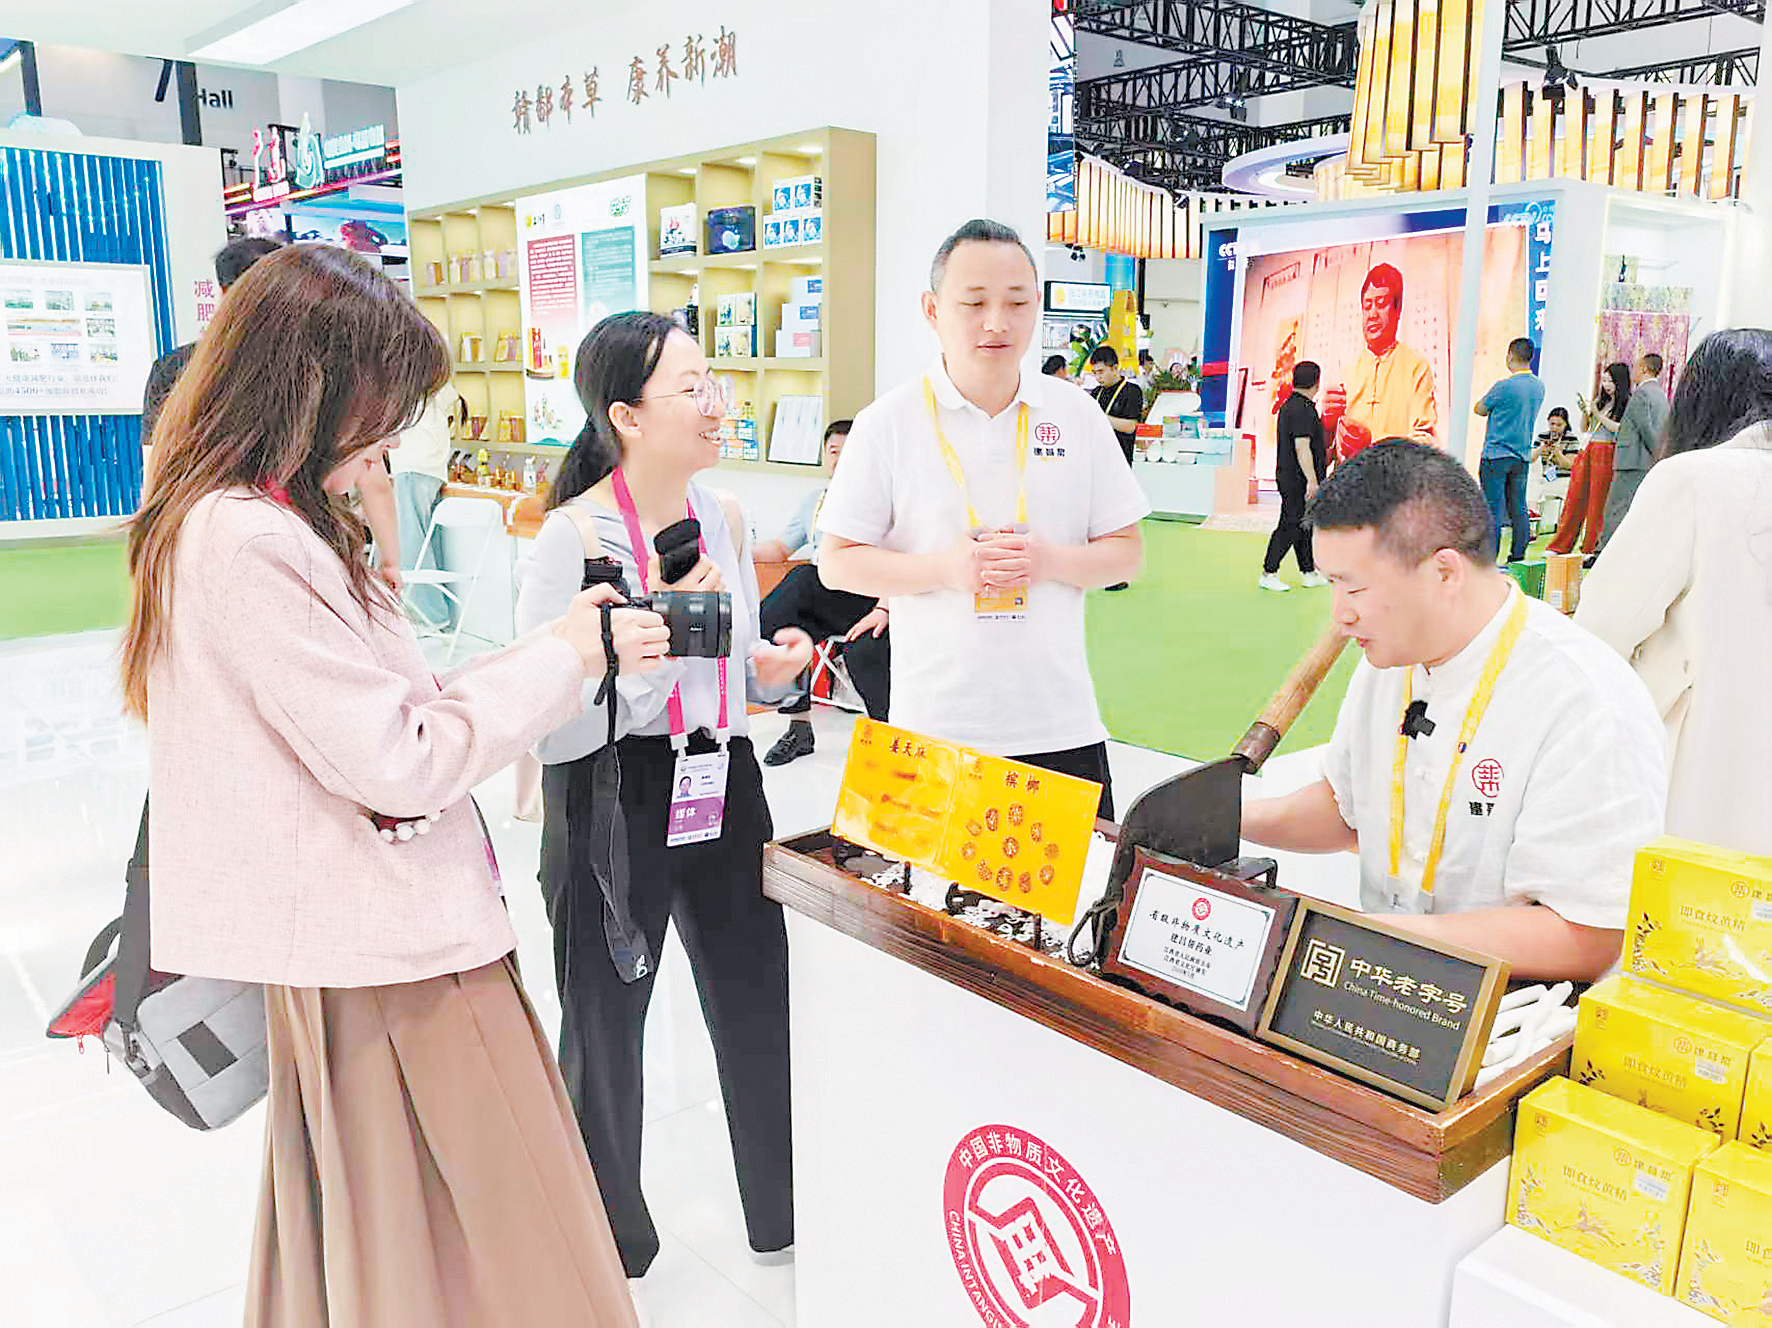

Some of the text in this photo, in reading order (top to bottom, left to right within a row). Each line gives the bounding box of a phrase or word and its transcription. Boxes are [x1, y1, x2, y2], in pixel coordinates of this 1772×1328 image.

[627, 25, 737, 105] 康养新潮
[1149, 910, 1245, 949] 省级非物质文化遗产
[1344, 980, 1460, 1030] China Time-honored Brand
[1349, 958, 1467, 1014] 中华老字号
[1313, 1010, 1420, 1059] 中华人民共和国商务部
[958, 1131, 1118, 1256] 中国非物质文化遗产
[949, 1210, 966, 1260] CHINA
